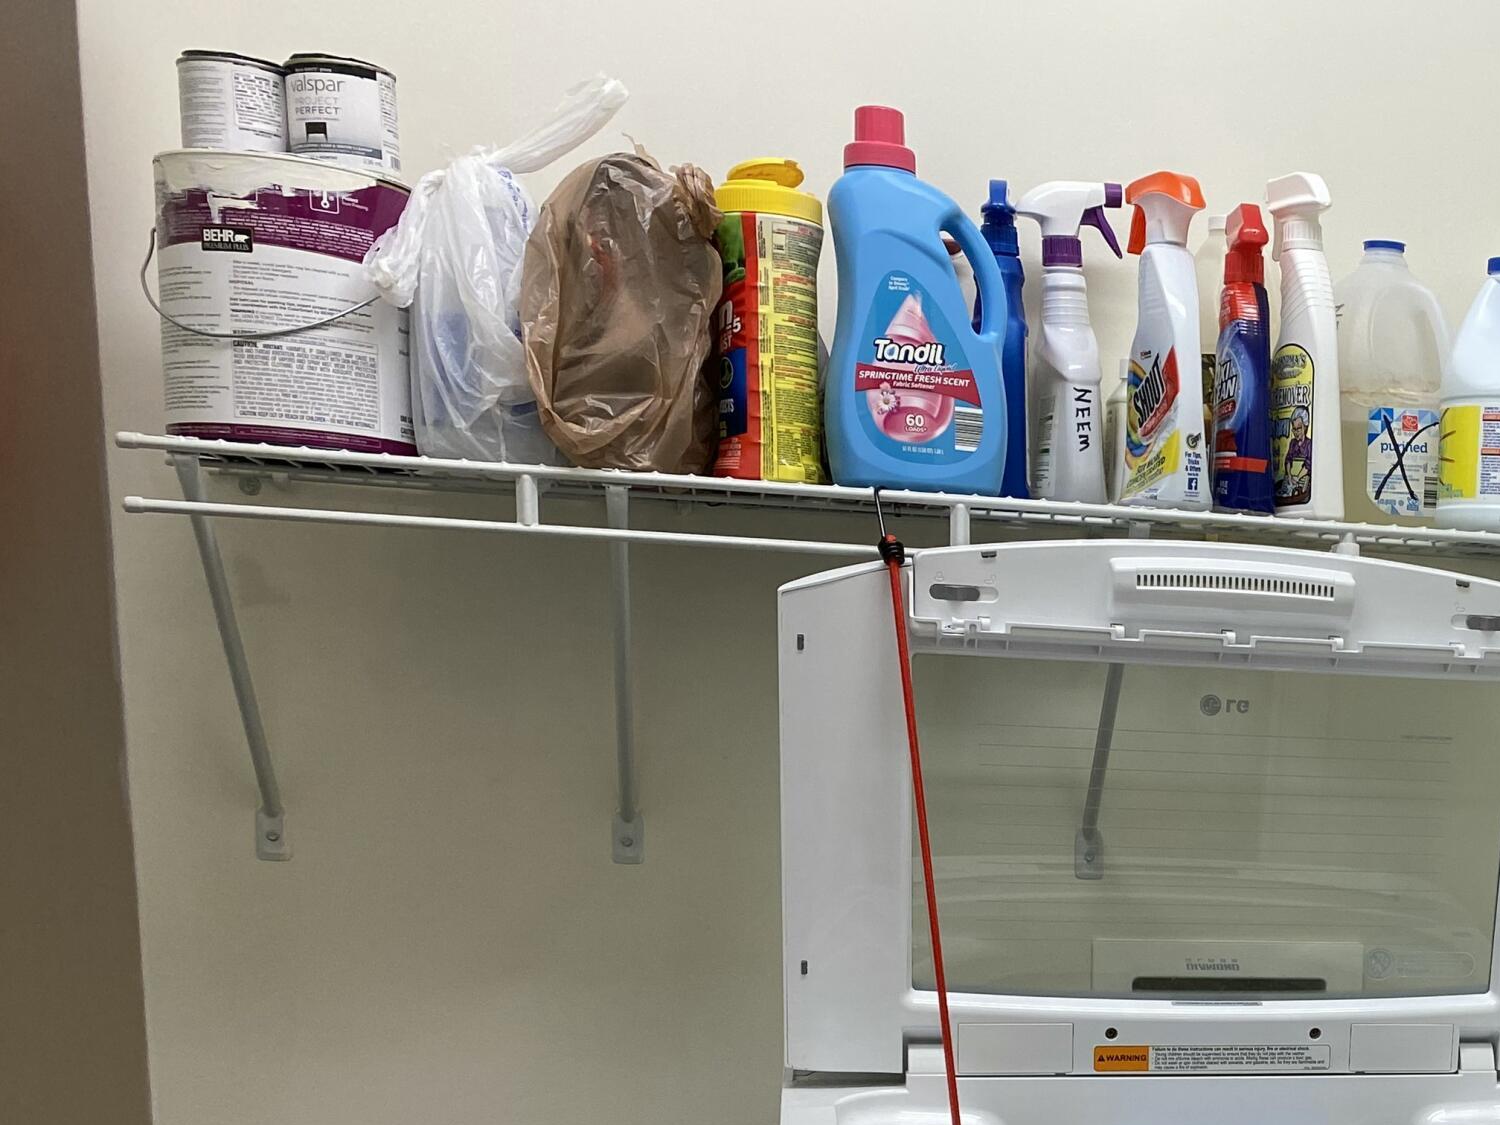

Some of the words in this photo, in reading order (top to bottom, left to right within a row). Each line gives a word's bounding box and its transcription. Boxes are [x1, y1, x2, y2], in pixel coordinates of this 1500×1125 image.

[290, 75, 345, 95] valspar
[294, 106, 340, 115] PERFECT
[203, 228, 234, 242] BEHR
[874, 338, 944, 365] Tandil
[858, 370, 913, 382] SPRINGTIME
[914, 374, 941, 384] FRESH
[942, 377, 970, 388] SCENT
[911, 382, 935, 390] Softener
[1132, 352, 1166, 428] SHOUT
[906, 414, 924, 427] 60
[1073, 386, 1092, 452] NEEM
[1380, 441, 1428, 453] puriied
[1105, 1054, 1147, 1062] WARNING
